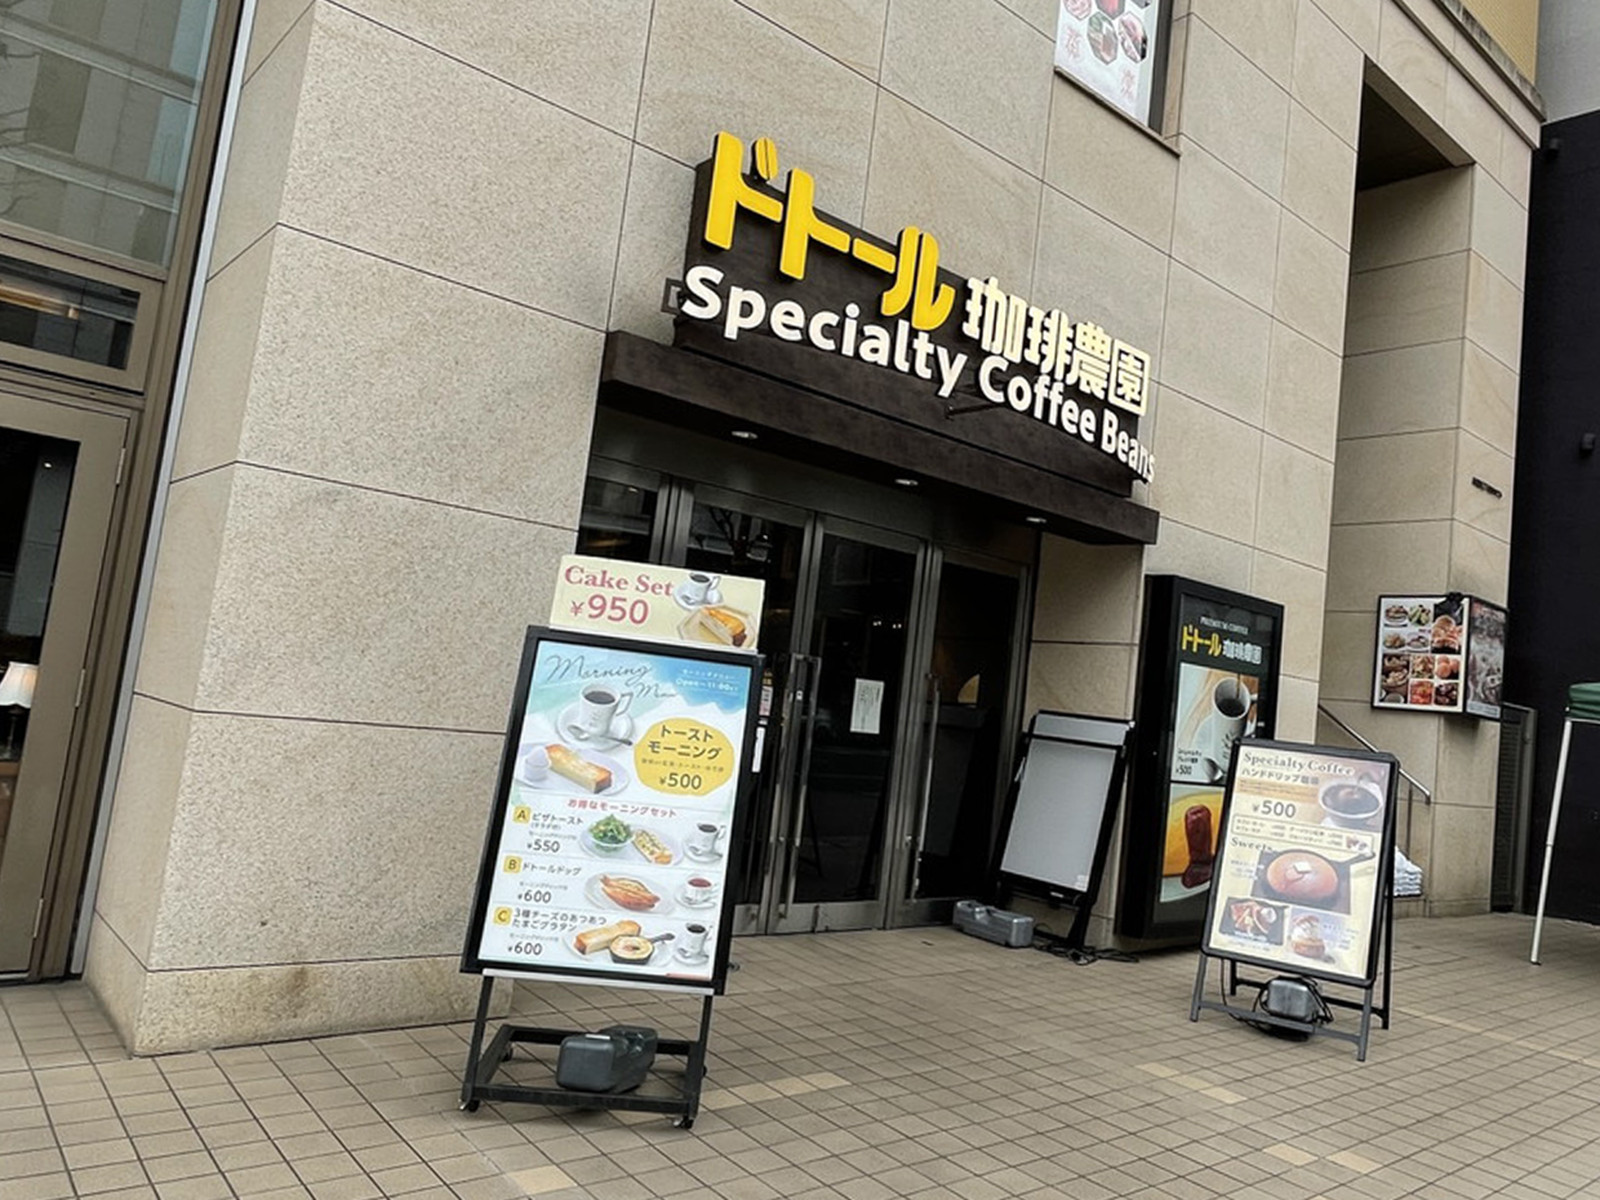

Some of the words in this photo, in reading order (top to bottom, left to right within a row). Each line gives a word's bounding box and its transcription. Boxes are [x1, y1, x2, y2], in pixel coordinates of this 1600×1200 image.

[704, 130, 956, 331] ドトール
[962, 276, 1152, 416] 珈琲農園
[681, 265, 968, 398] Specialty
[978, 354, 1097, 443] Coffee
[1101, 408, 1155, 483] Beans
[565, 565, 629, 590] Cake
[635, 574, 675, 596] Set
[570, 594, 649, 625] ¥950
[661, 725, 714, 742] トースト
[648, 741, 723, 760] モーニング
[1244, 752, 1305, 772] Specialty
[1308, 760, 1354, 775] Coffee
[517, 809, 527, 820] A
[508, 859, 518, 870] B
[497, 910, 509, 922] C
